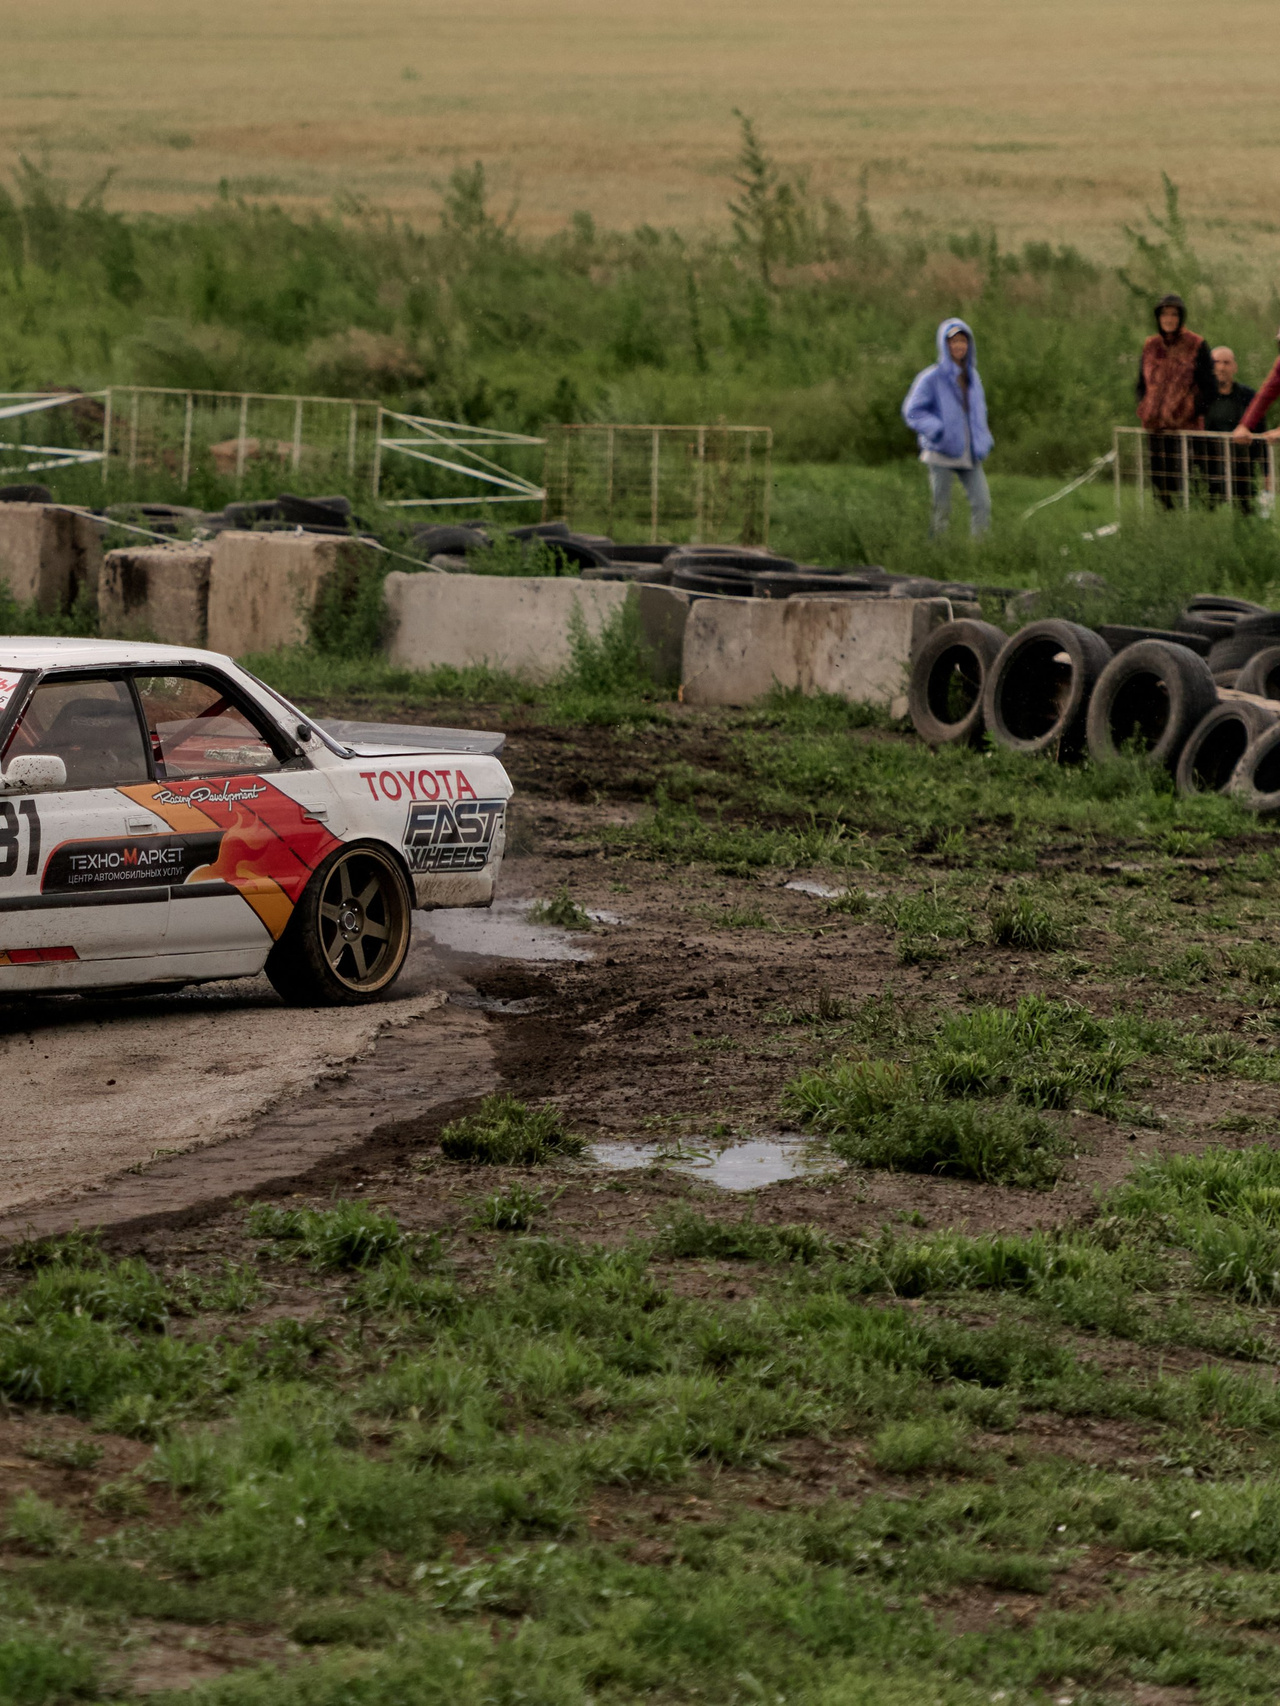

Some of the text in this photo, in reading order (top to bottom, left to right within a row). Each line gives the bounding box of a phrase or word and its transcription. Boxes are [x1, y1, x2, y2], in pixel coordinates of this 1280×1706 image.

[358, 769, 478, 801] TOYOTA
[153, 788, 192, 808] Racing
[404, 801, 506, 845] FAST
[69, 847, 184, 870] ТЕХНО-МАРКЕТ
[404, 845, 489, 870] WHEELS
[68, 866, 185, 884] ЦЕНТР АВТОМОБИЛЬНЫХ УСЛУГ
